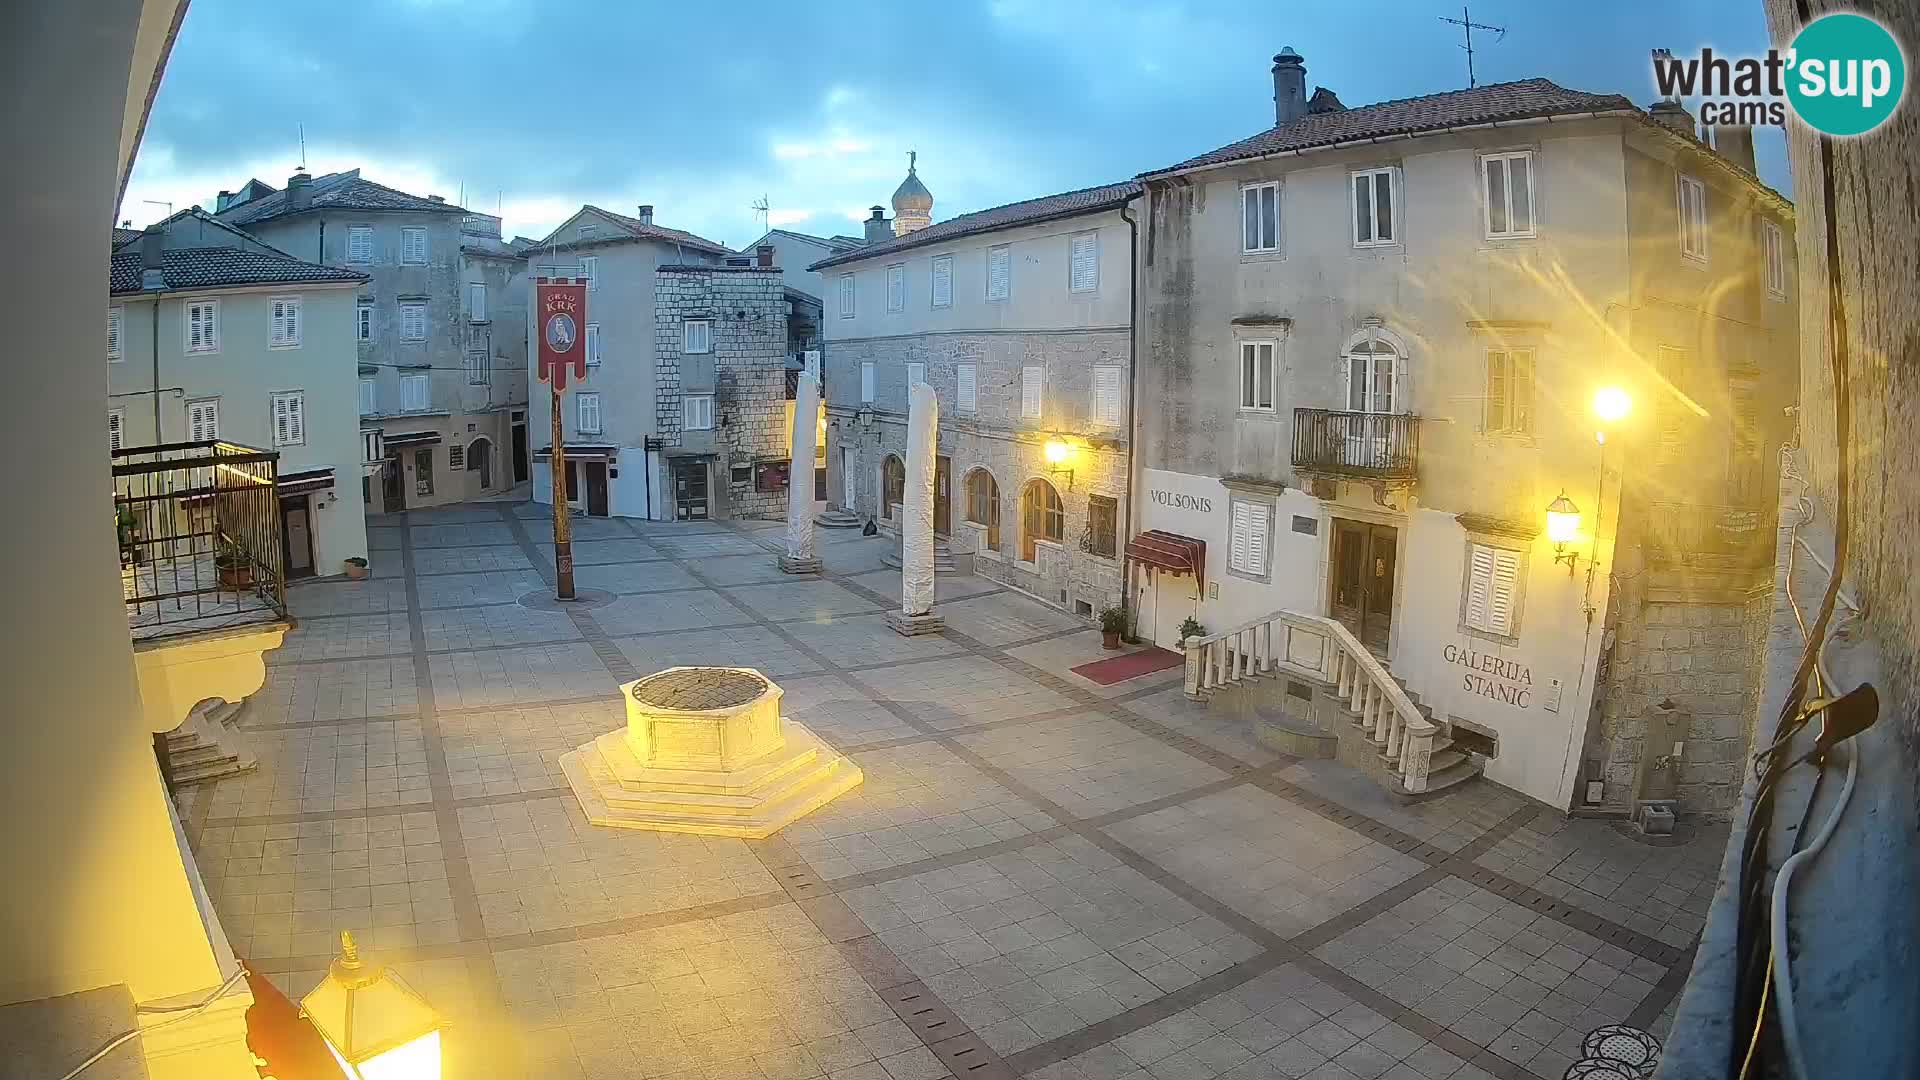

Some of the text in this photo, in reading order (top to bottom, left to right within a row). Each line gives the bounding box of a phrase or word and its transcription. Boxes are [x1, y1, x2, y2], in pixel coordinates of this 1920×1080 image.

[546, 300, 577, 313] KRK
[547, 293, 576, 302] GRAD
[1151, 489, 1212, 513] VOLSONIS
[1443, 644, 1533, 686] GALERIJA
[1463, 673, 1532, 709] STANIĆ
